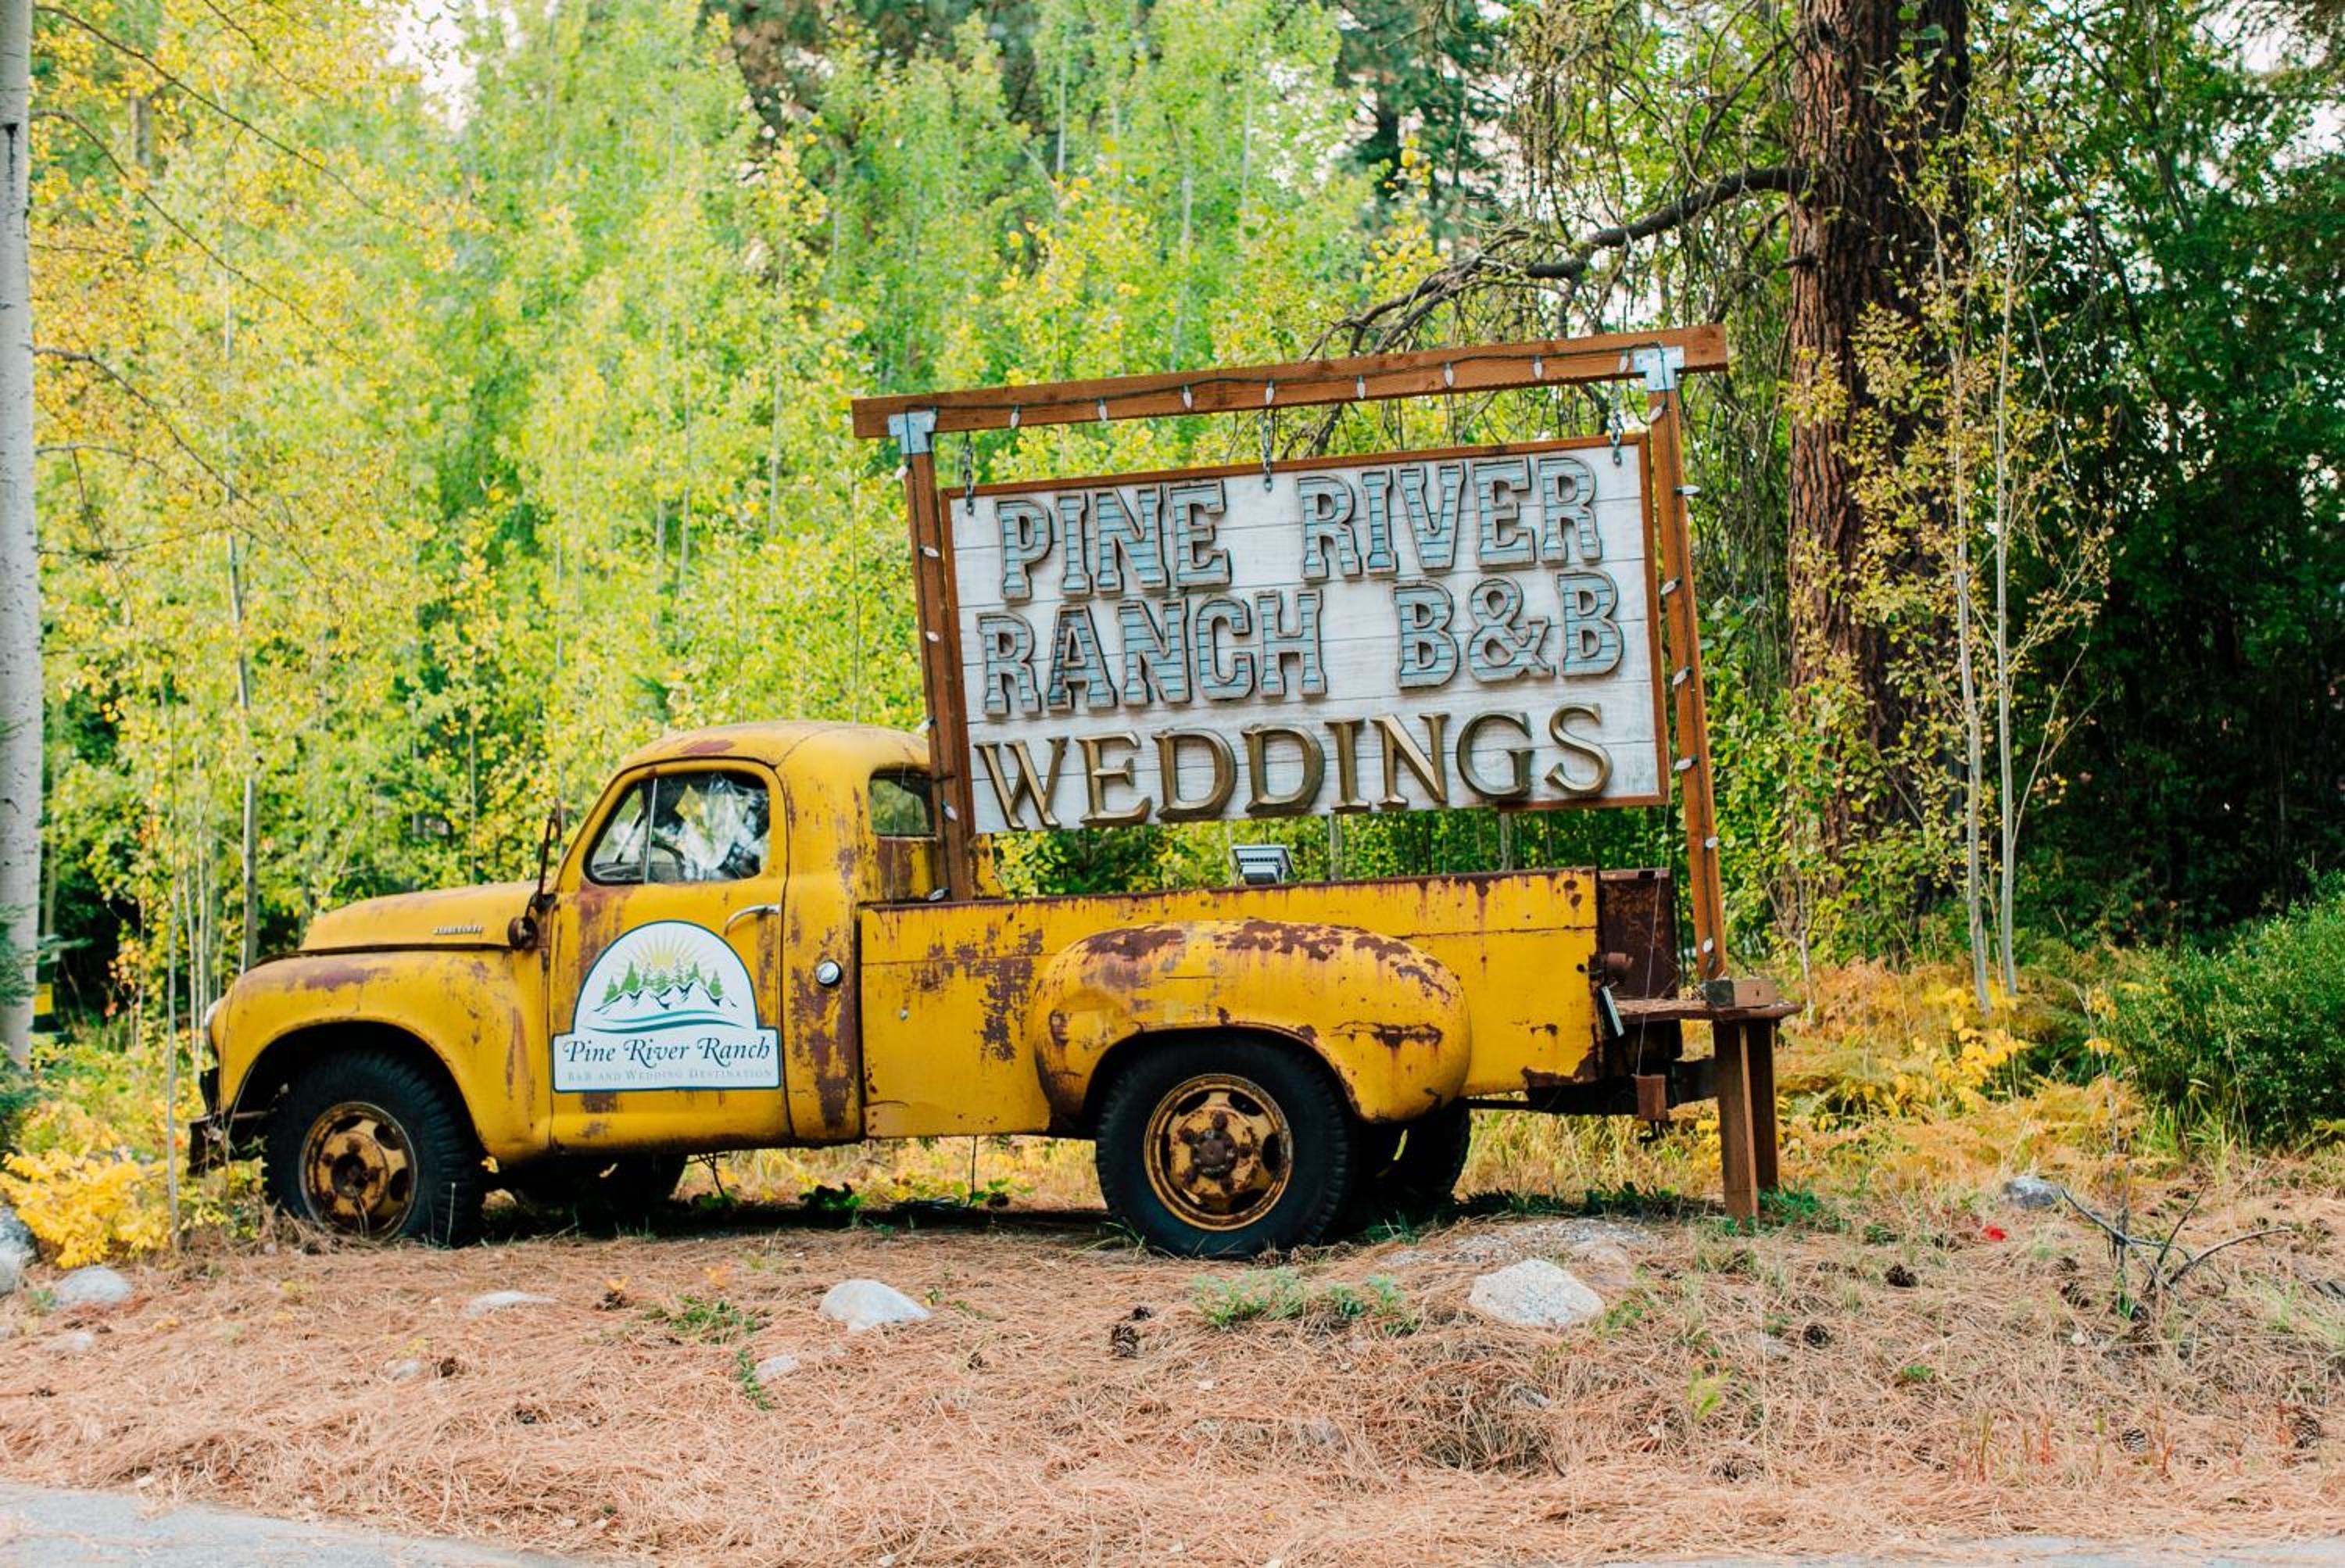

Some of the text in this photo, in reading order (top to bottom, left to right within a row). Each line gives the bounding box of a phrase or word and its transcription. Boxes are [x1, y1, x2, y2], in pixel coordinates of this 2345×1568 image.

[993, 456, 1602, 601] PINE RIVER
[976, 568, 1624, 717] RANCH B&B
[973, 703, 1614, 831] WEDDINGS
[563, 1036, 771, 1069] Pine River Ranch
